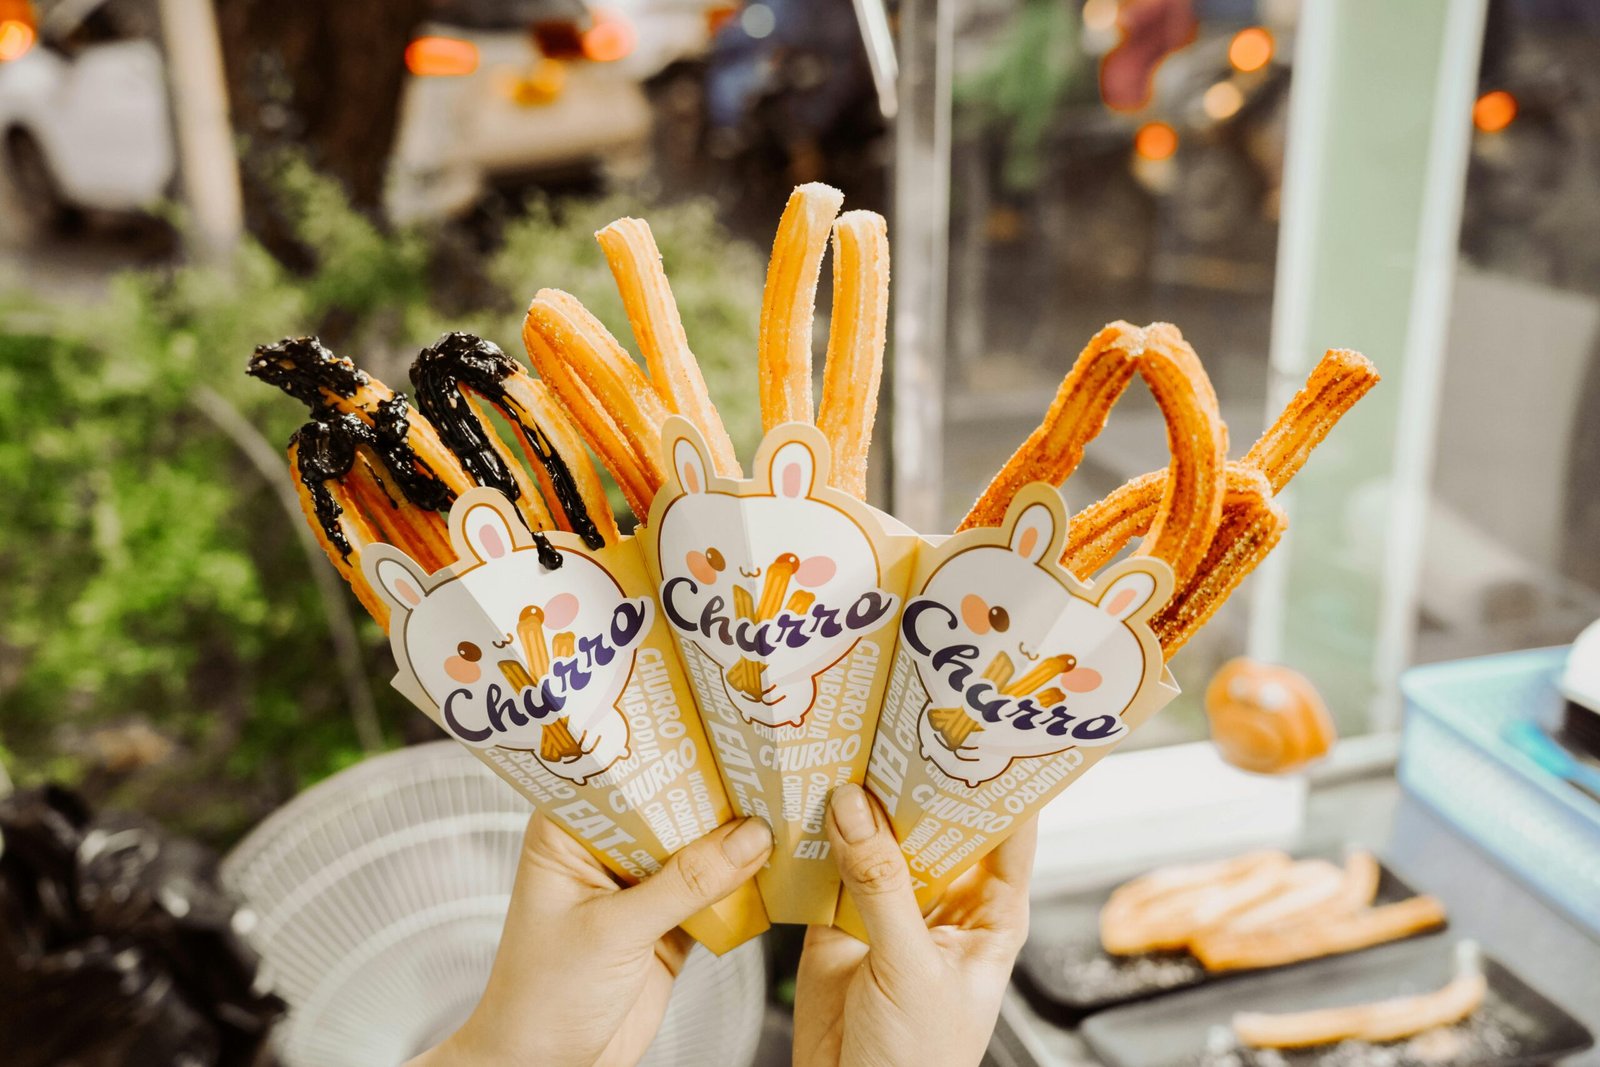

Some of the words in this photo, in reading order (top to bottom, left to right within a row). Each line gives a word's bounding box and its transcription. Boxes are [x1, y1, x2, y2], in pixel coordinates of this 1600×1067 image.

[662, 576, 893, 657] Churro
[444, 600, 646, 742] Churro
[637, 647, 686, 739] CHURRO
[699, 655, 739, 724] CHURR
[837, 640, 881, 731] CHURRO
[881, 650, 911, 728] CAMBODIA
[902, 600, 1124, 740] Churro
[895, 675, 926, 752] CHURR
[484, 748, 553, 803] CAMBODIA
[508, 752, 577, 799] CHURR
[609, 737, 697, 814] CHURRO
[708, 720, 764, 792] EAT
[759, 734, 861, 772] CHURRO
[867, 728, 909, 817] EAT
[1004, 749, 1084, 814] CHURRO
[552, 799, 637, 850] EAT
[644, 802, 681, 852] CHURRO
[667, 788, 702, 845] HURRO
[688, 770, 719, 829] AMBODIA
[782, 775, 803, 821] CHURRO
[801, 772, 830, 834] CHURRO
[911, 784, 1014, 833] CHURRO
[901, 817, 942, 855] CHURRO
[910, 827, 963, 873] CHURRO
[929, 834, 987, 879] CAMBODIA
